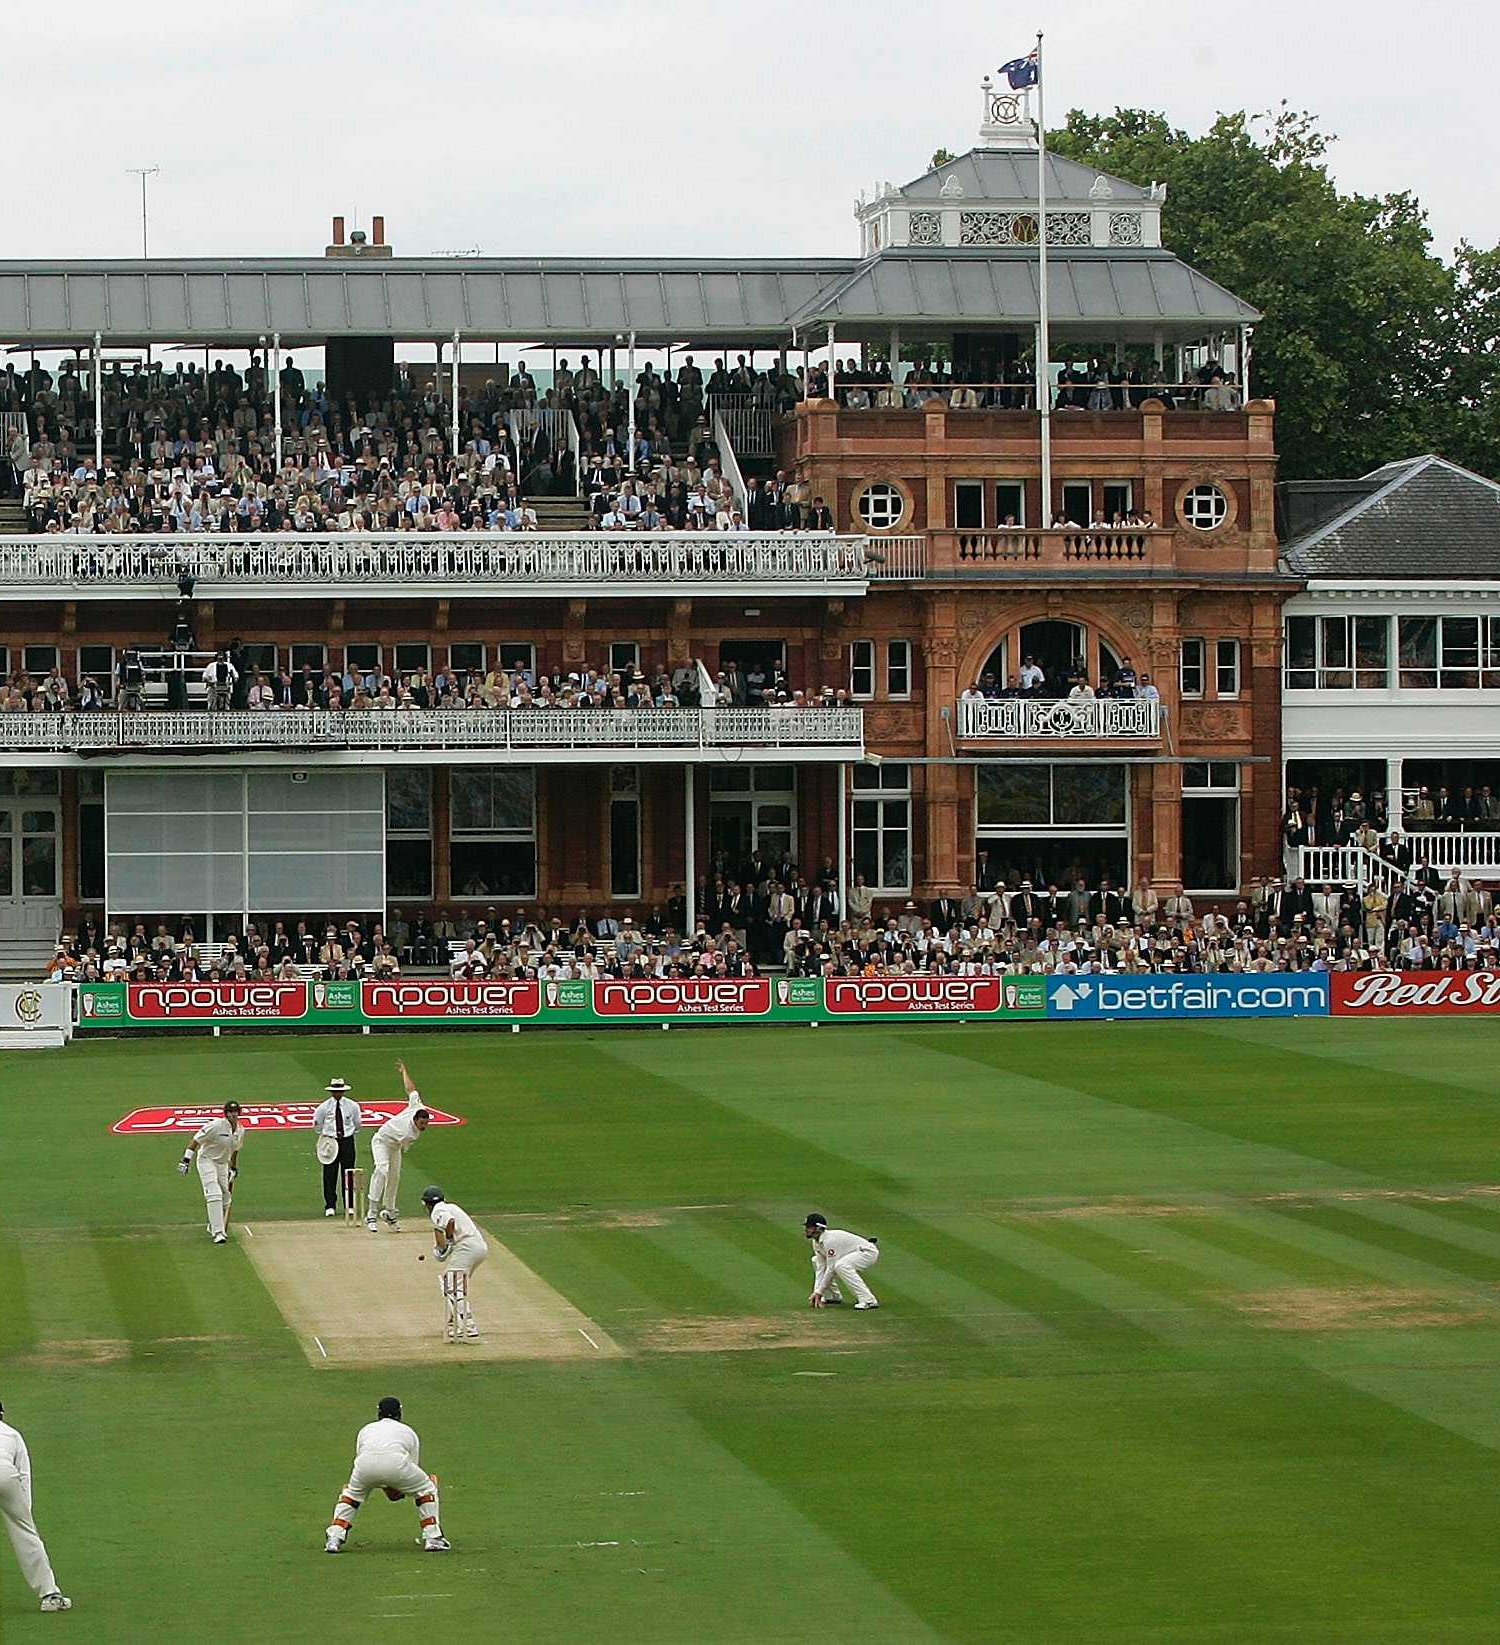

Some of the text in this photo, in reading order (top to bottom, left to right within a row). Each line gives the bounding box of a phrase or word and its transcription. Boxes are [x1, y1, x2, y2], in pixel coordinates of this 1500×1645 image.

[327, 991, 351, 1001] Ashes
[560, 990, 584, 999] Ashes
[605, 984, 760, 1011] npower
[836, 982, 990, 1009] npower
[1099, 981, 1326, 1010] betfair.com
[1343, 973, 1453, 1007] Red
[139, 987, 297, 1015] npower
[373, 986, 529, 1013] npower
[677, 1003, 744, 1012] Ashes Test Series
[908, 1001, 975, 1010] Ashes Test Series
[212, 1007, 281, 1016] Ashes Test Series
[445, 1006, 471, 1015] Ashes
[489, 1006, 514, 1015] Series
